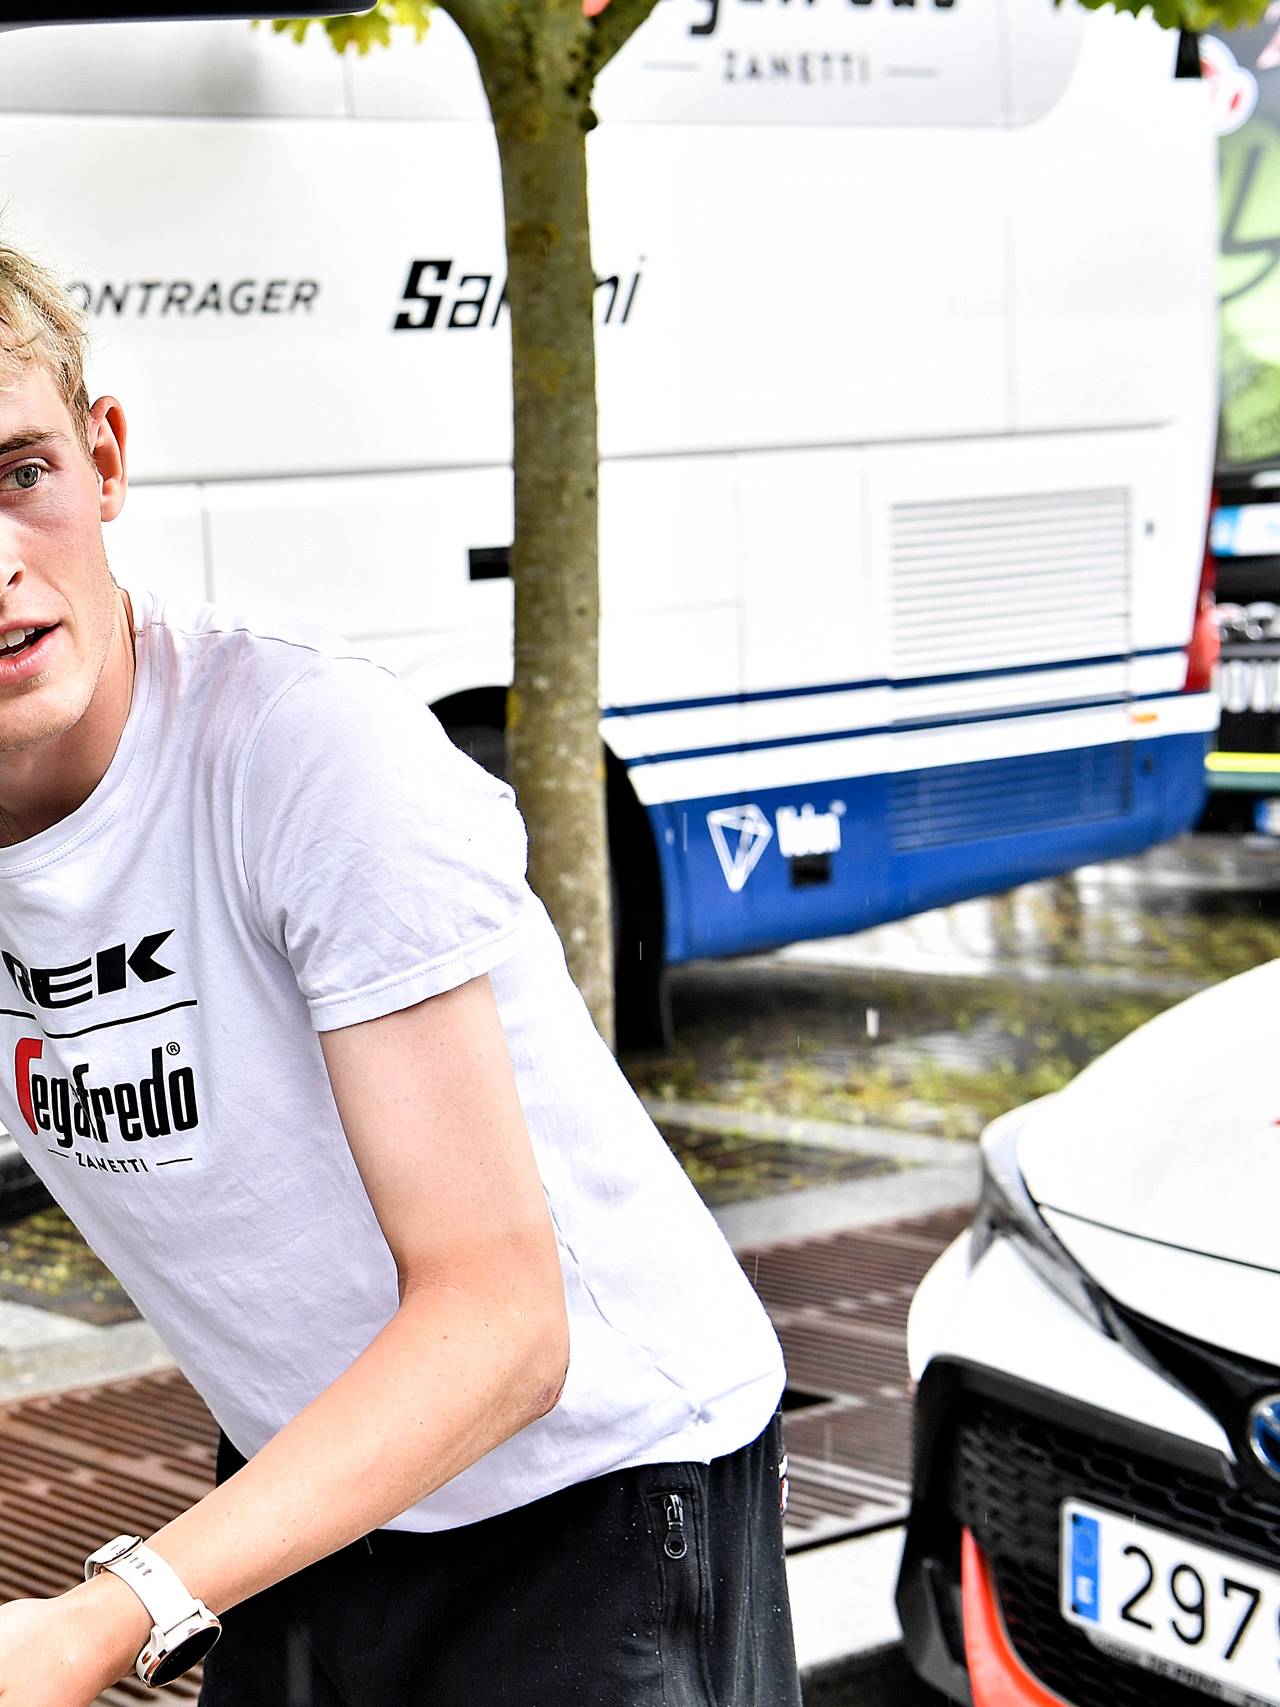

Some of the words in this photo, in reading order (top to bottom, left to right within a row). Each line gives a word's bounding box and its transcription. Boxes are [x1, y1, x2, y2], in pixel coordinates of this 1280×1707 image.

[724, 51, 870, 84] ZANETTI
[66, 279, 319, 316] ONTRAGER
[75, 1151, 149, 1173] ZANETTI
[1121, 1546, 1280, 1660] 297
